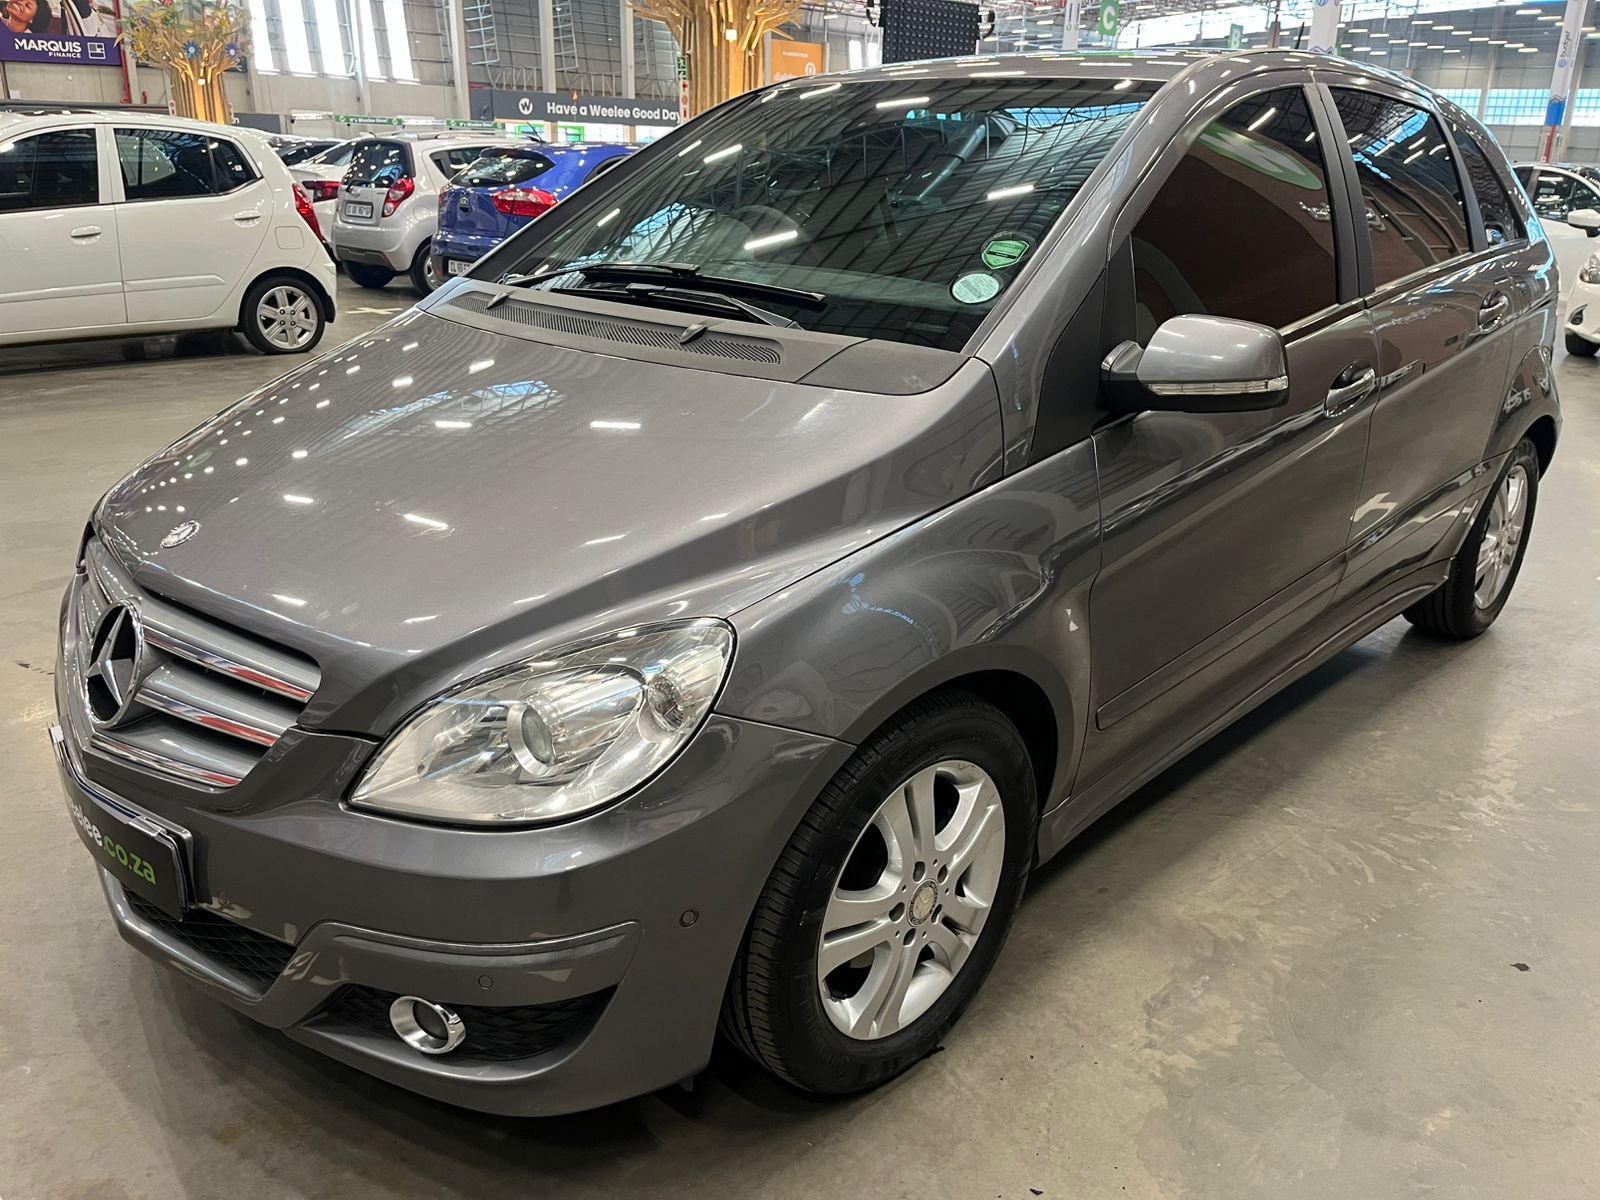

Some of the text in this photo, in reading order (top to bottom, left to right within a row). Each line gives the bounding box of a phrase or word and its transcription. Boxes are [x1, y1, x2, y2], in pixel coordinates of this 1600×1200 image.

[1103, 6, 1116, 30] C
[14, 38, 82, 53] MARQUIS
[48, 51, 81, 59] FINANCE
[547, 102, 681, 124] Have a Weelee Good Day
